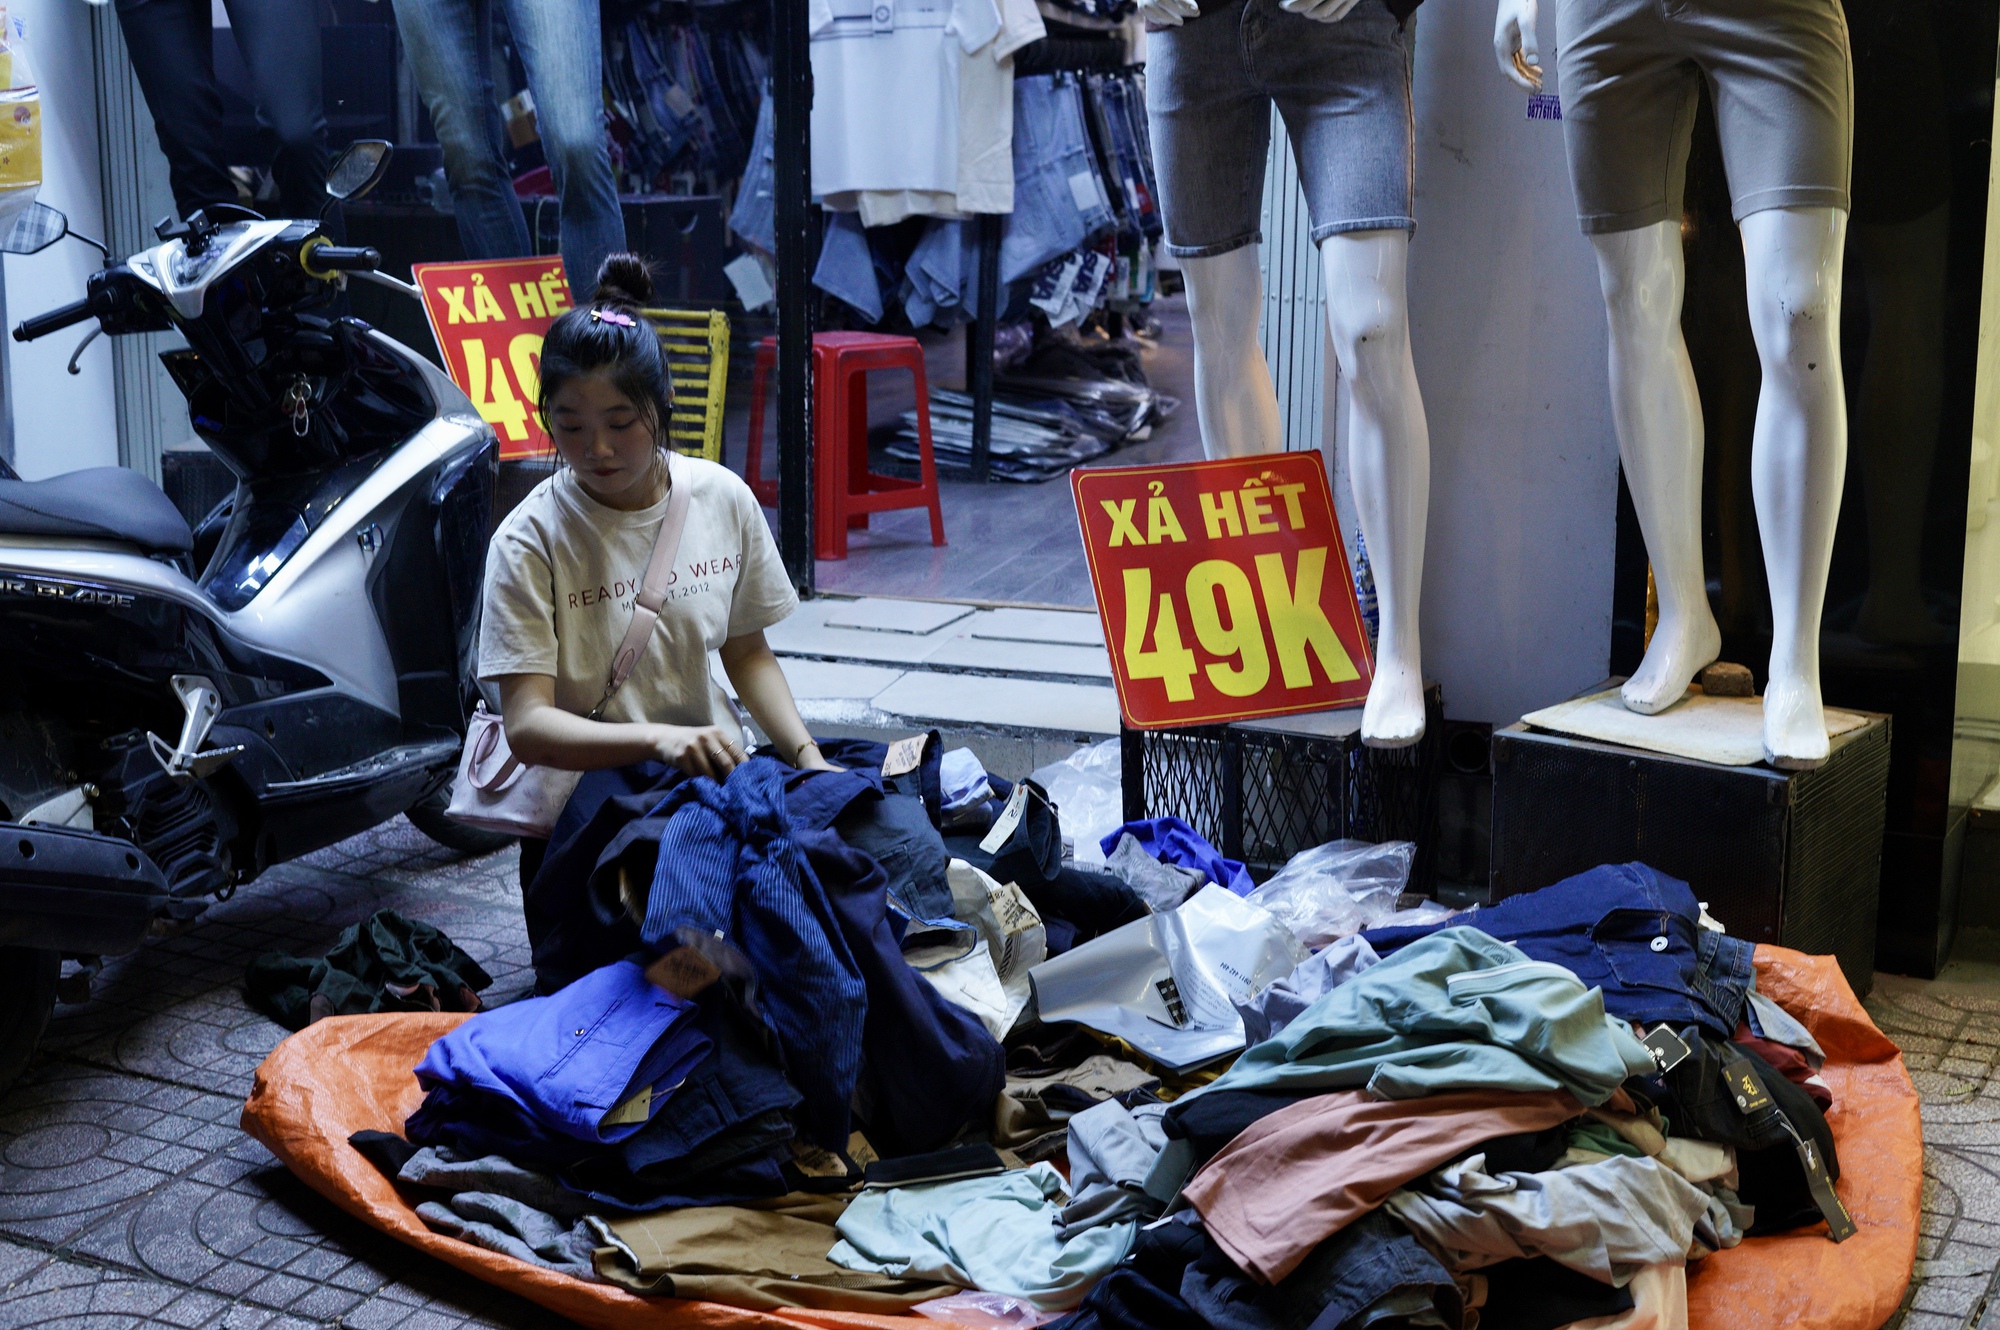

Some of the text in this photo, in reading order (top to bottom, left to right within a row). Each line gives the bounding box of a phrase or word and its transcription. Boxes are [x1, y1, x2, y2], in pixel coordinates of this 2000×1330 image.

[437, 267, 571, 325] XẢ HẾ
[1100, 471, 1306, 547] XẢ HẾT
[35, 581, 136, 608] BLADE
[568, 578, 636, 610] READY
[1122, 546, 1361, 703] 49K
